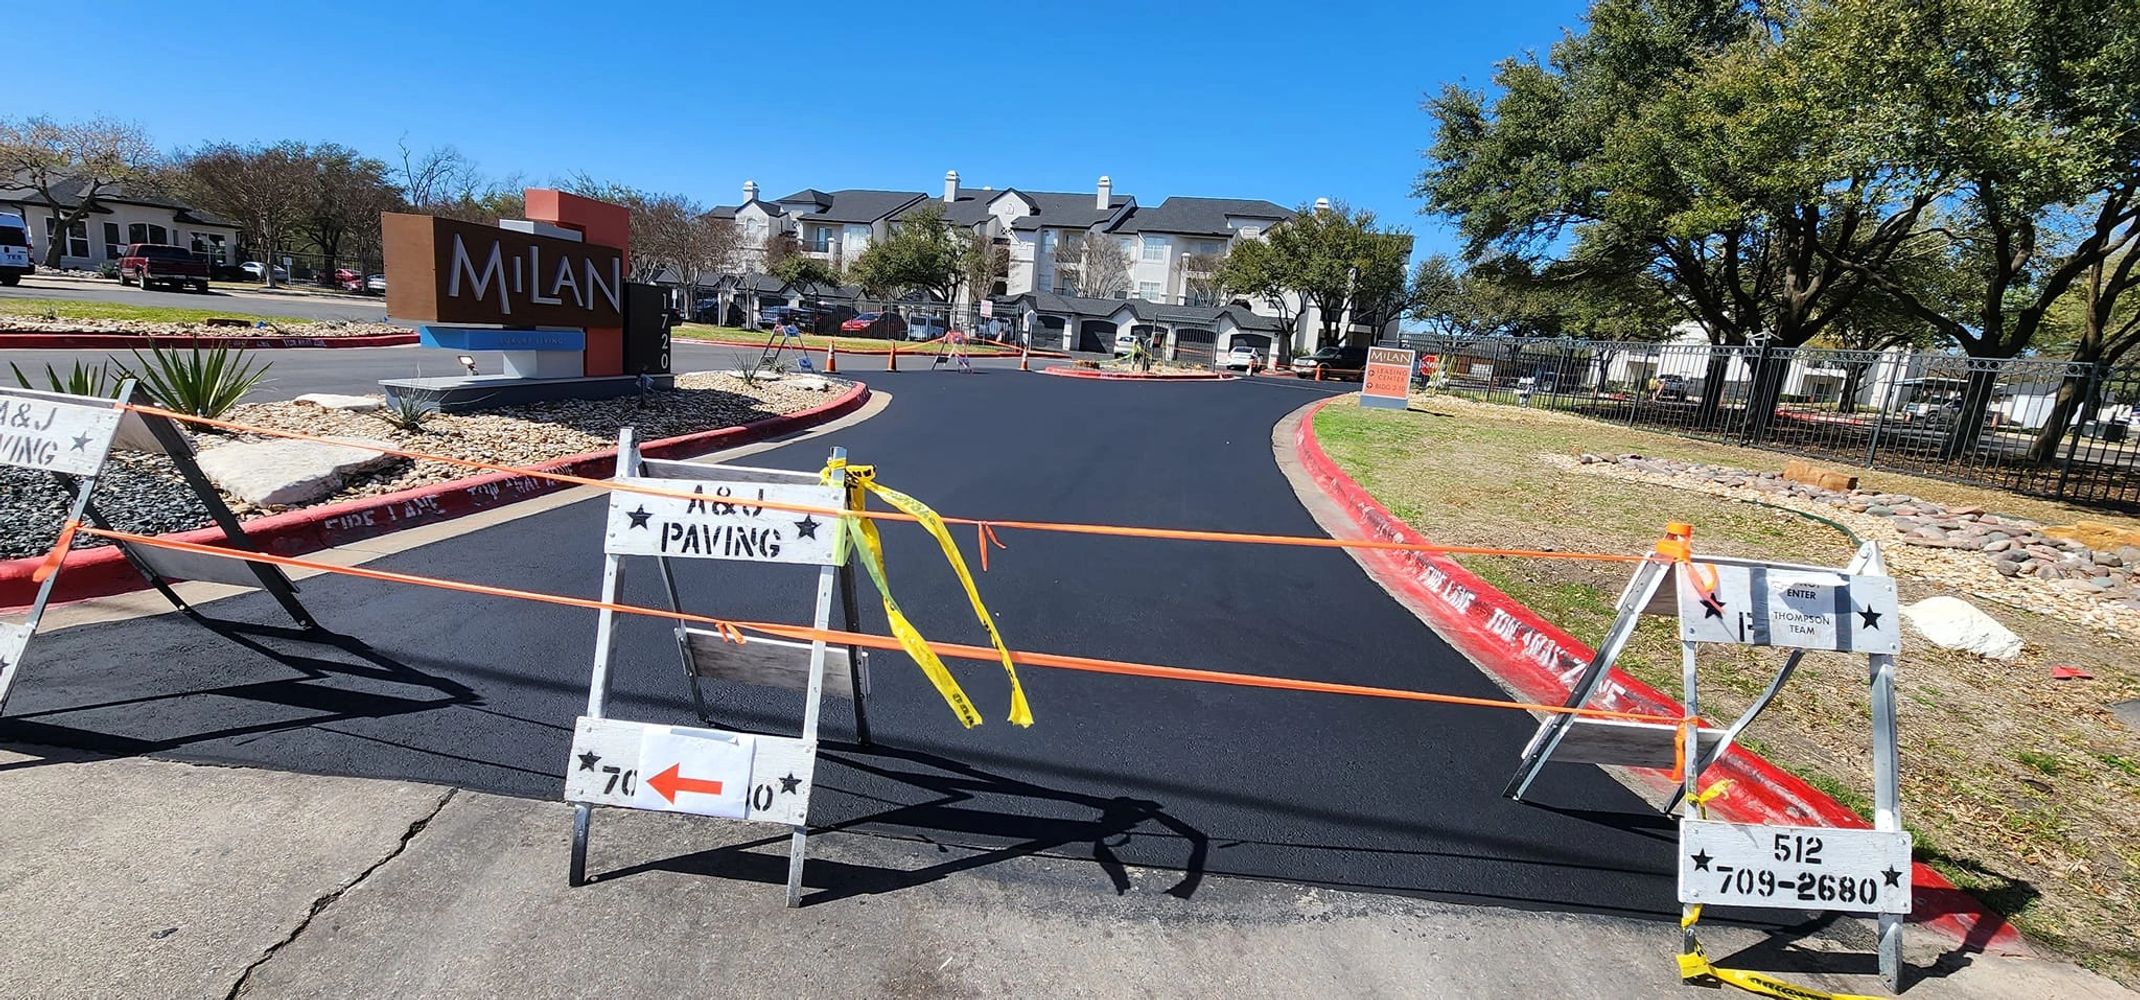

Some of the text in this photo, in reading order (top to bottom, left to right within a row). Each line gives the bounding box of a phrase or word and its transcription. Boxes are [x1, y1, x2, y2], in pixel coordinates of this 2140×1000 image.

[660, 292, 669, 369] 1720
[1370, 351, 1411, 363] MILAN
[1377, 368, 1408, 376] LEASING
[1378, 374, 1405, 382] CENTER
[686, 484, 764, 517] A&J
[661, 522, 781, 558] PAVING
[1786, 589, 1817, 601] ENTER
[1773, 611, 1831, 626] THOMPSON
[1789, 624, 1816, 636] TEAM
[1774, 833, 1824, 865] 512
[1716, 865, 1878, 905] 709-2680
